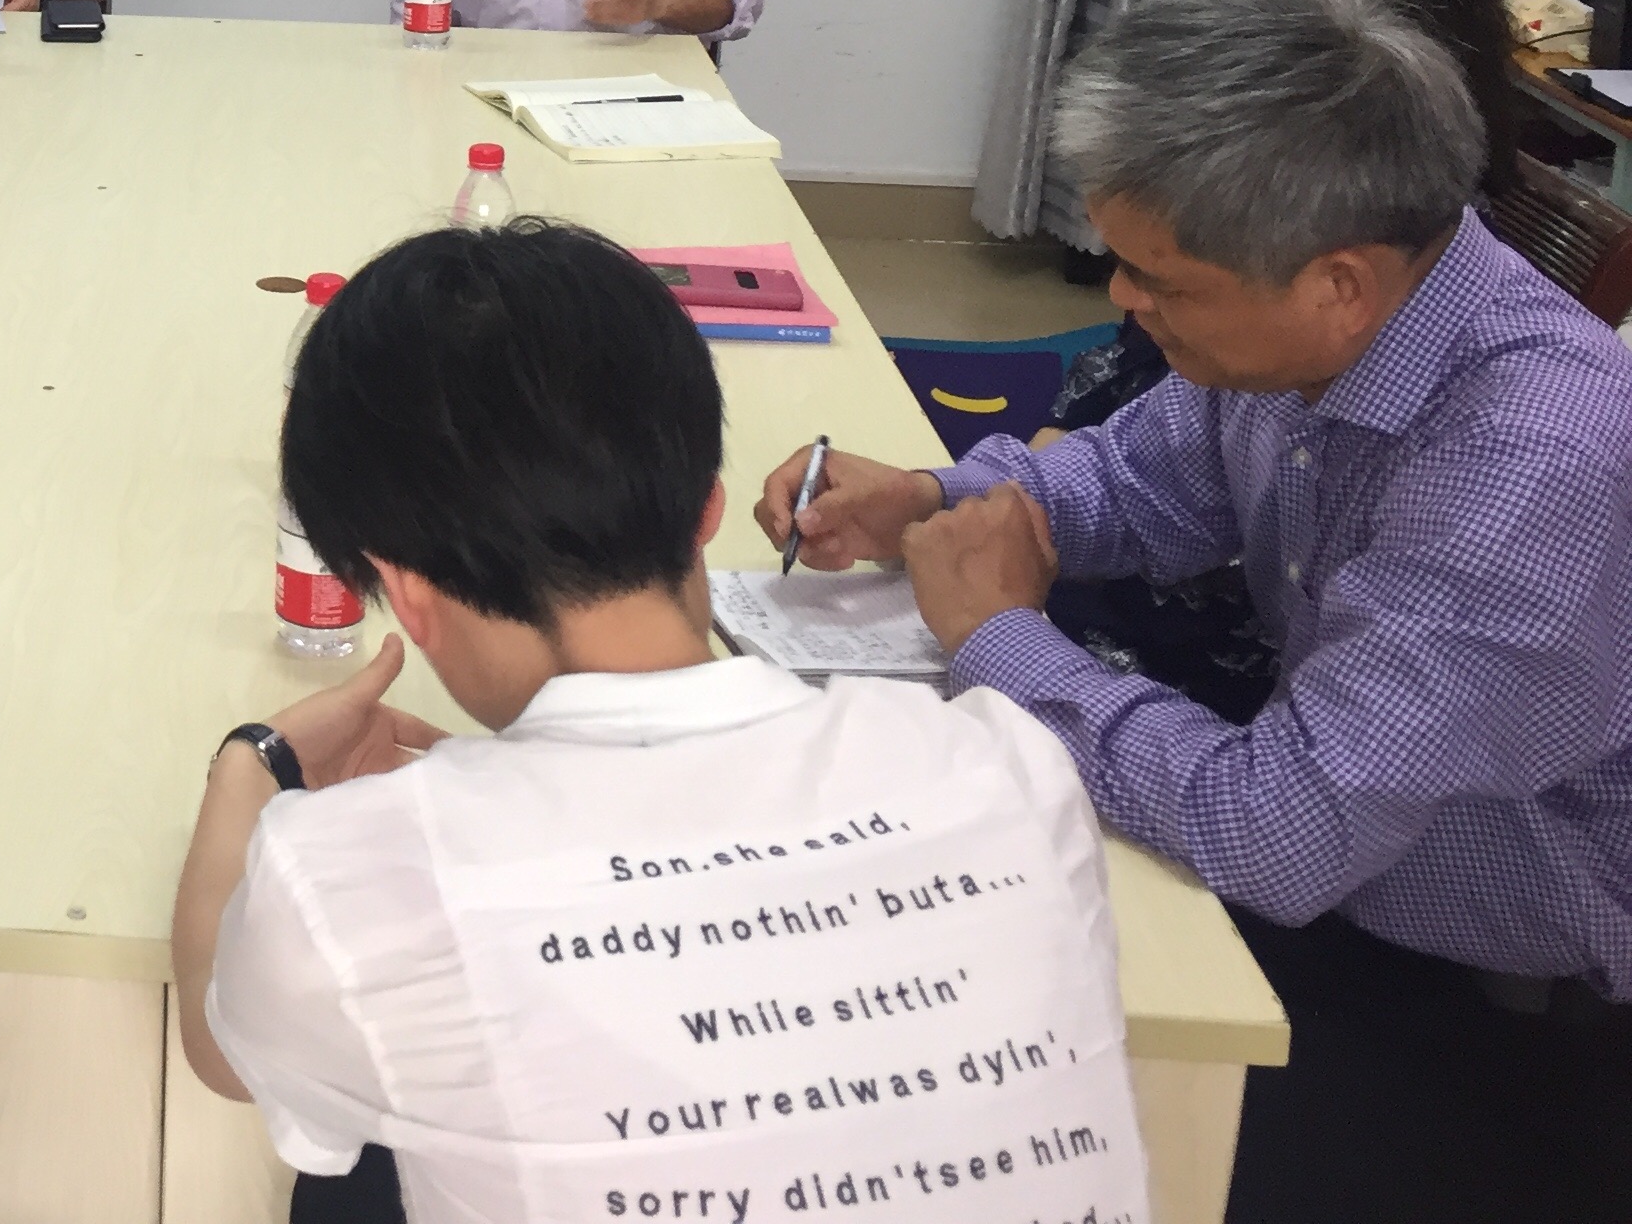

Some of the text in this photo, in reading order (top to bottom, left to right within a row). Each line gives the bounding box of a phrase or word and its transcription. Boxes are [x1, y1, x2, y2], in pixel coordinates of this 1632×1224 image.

[539, 922, 682, 964] daddy
[700, 892, 859, 946] nothin'
[680, 968, 969, 1044] While sittin'
[606, 1186, 751, 1224] sorry
